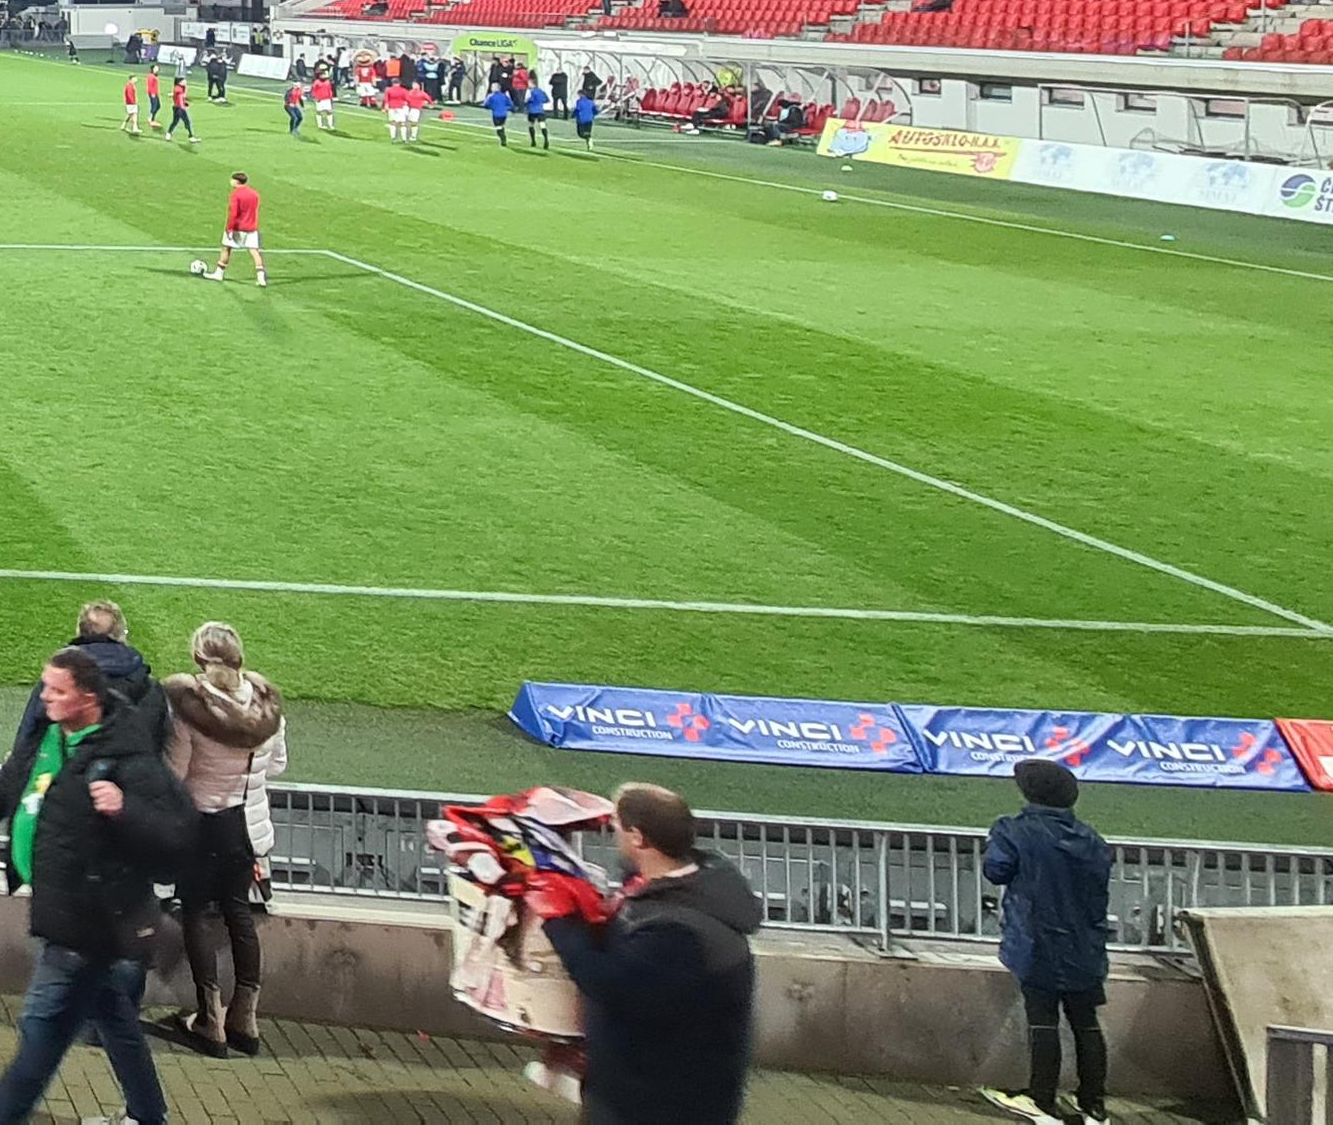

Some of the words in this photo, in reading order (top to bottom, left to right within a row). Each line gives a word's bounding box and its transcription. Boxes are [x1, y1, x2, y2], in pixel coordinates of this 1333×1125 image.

[547, 704, 657, 728] VINCI
[592, 726, 673, 740] CONSTRUCTION
[728, 717, 843, 741] VINCI
[923, 728, 1036, 752] VINCI
[777, 739, 860, 754] CONSTRUCTION
[1107, 738, 1227, 762] VINCI
